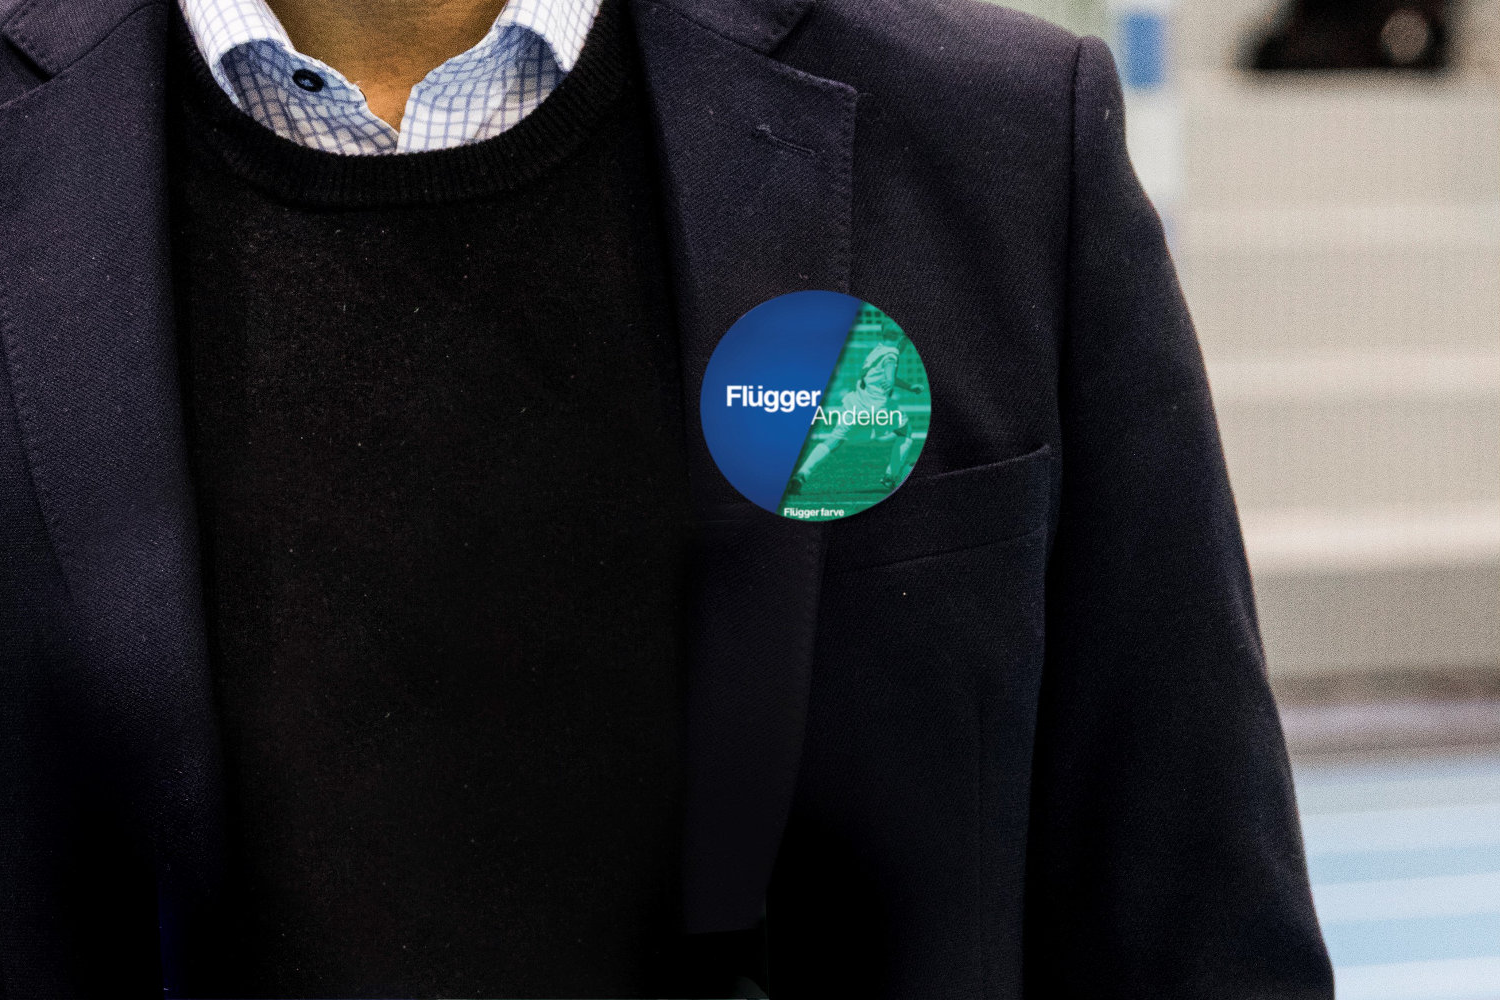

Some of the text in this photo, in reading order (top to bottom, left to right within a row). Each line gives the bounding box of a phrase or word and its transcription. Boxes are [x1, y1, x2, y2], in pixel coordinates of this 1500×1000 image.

[726, 385, 821, 413] Flügger
[811, 405, 902, 426] Andelen
[783, 507, 844, 518] Flügger farve
